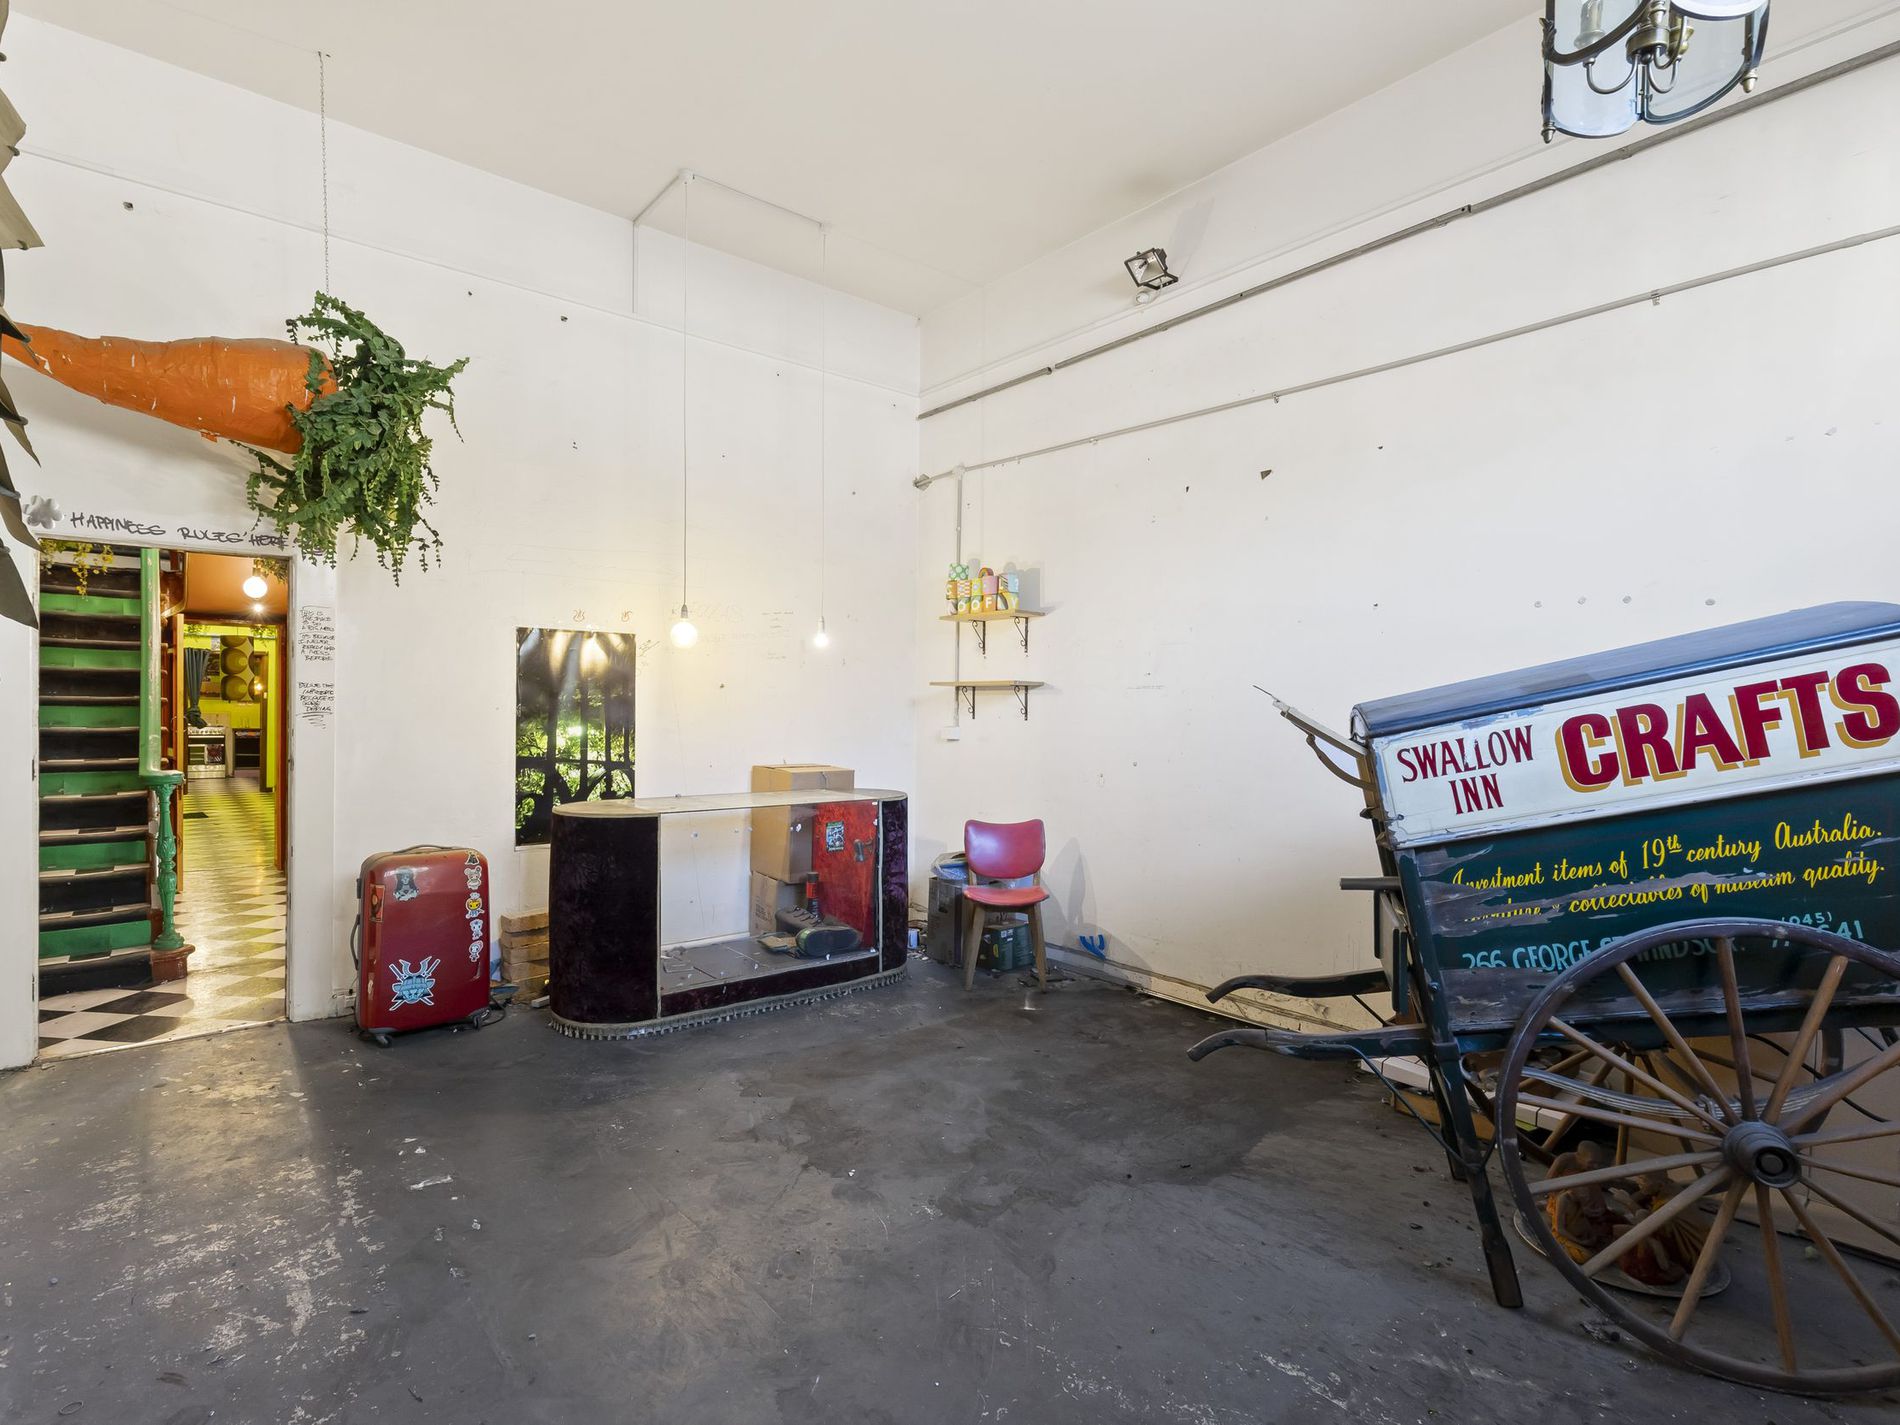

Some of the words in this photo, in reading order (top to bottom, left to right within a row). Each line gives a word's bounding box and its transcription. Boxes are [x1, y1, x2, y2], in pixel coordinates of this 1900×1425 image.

[70, 511, 167, 536] HAPPINESS
[1396, 724, 1533, 784] SWALLOW
[1555, 662, 1900, 793] CRAFTS
[1449, 773, 1504, 815] INN
[1552, 858, 1603, 882] items
[1608, 850, 1629, 879] of
[1686, 834, 1762, 863] century
[1774, 812, 1883, 850] Australia.
[1690, 882, 1709, 904] of
[1802, 850, 1885, 888] quality.
